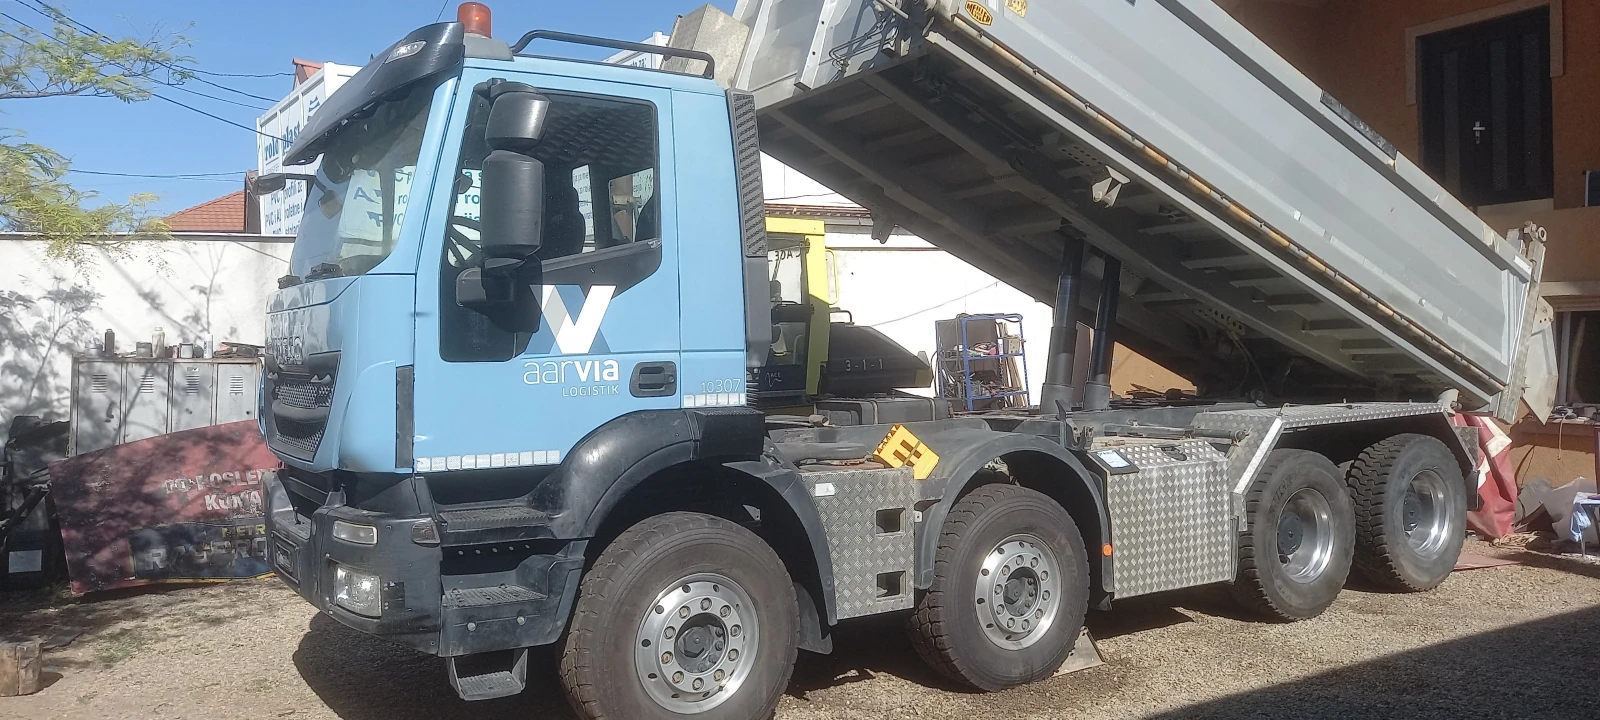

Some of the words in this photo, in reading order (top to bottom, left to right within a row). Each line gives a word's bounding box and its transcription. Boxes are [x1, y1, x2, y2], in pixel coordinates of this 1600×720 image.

[845, 358, 883, 371] 3-1-1
[523, 359, 619, 385] aarvia
[562, 384, 620, 397] LOGISTIK
[701, 378, 741, 393] 10307
